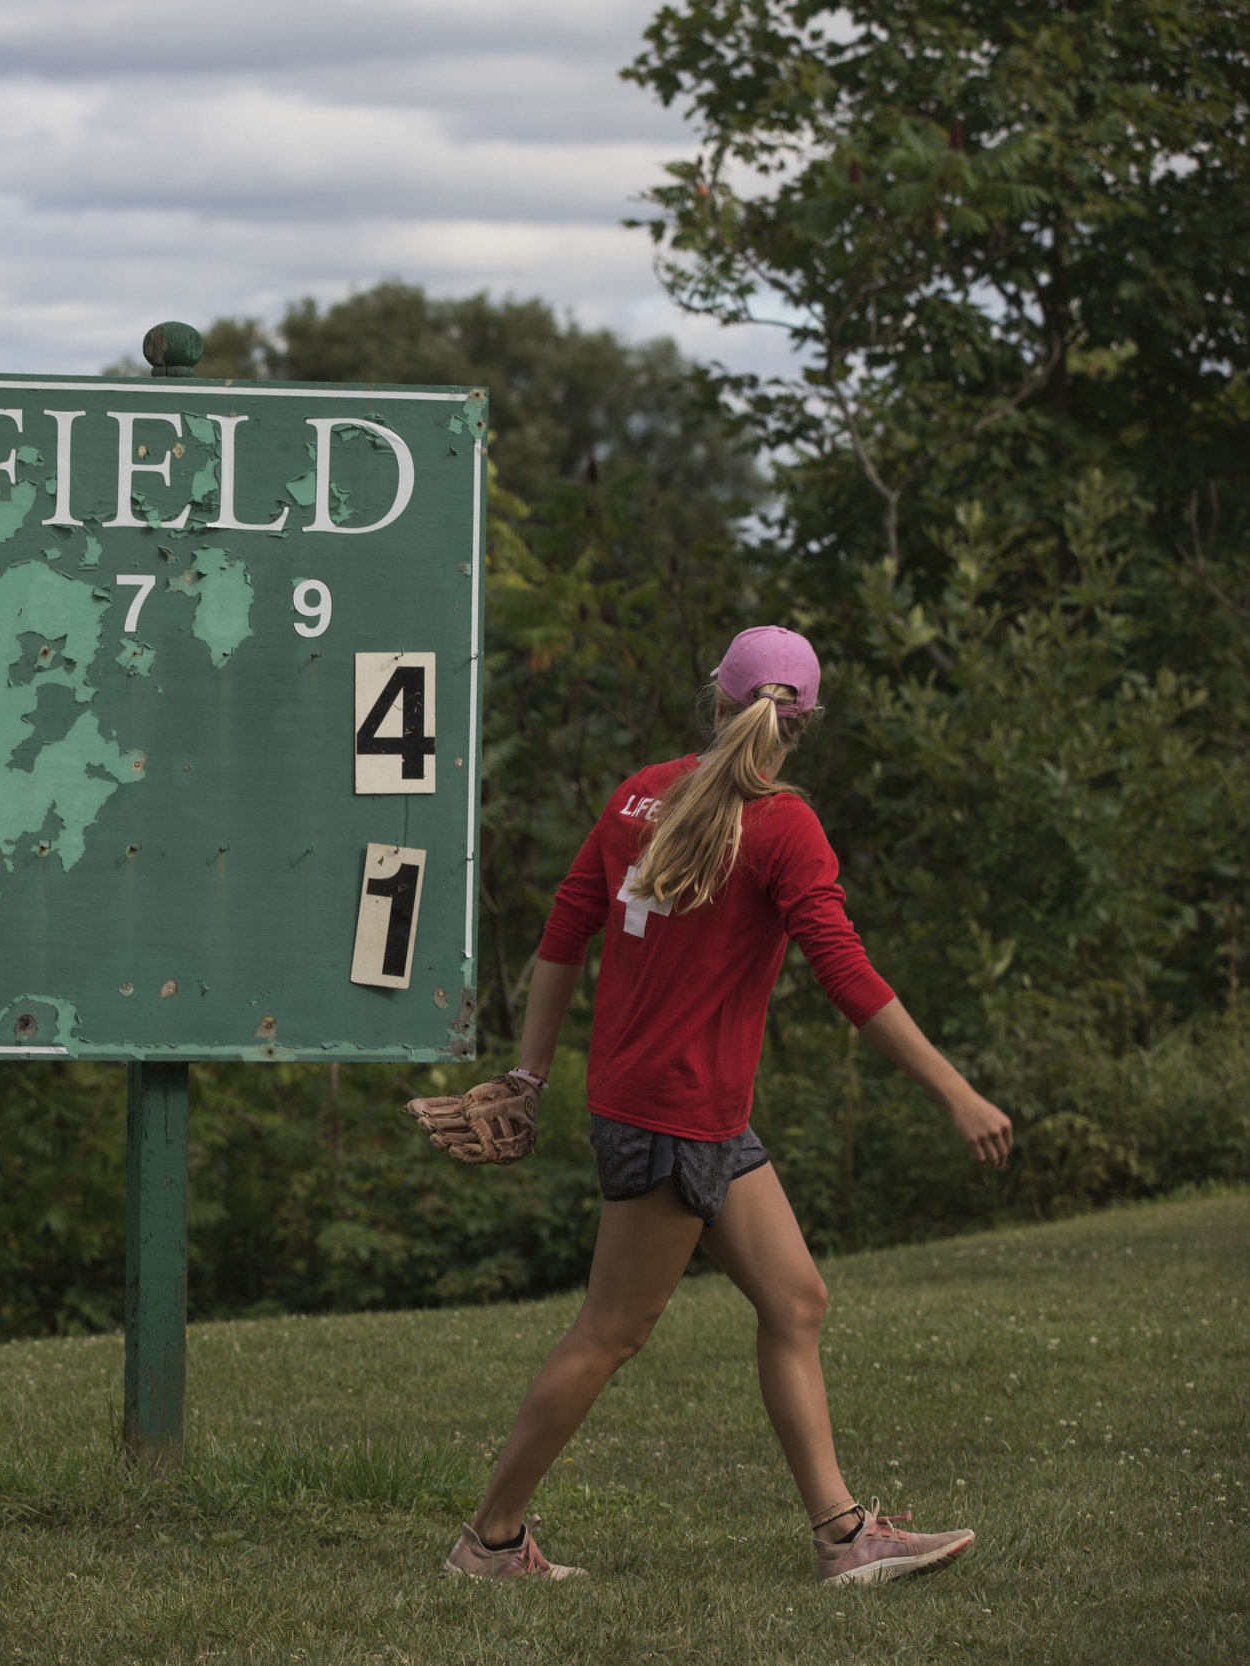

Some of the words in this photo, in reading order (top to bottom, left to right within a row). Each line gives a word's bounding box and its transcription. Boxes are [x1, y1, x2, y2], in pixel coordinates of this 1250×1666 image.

[116, 574, 156, 632] 7
[292, 579, 332, 638] 9
[356, 666, 435, 779] 4
[366, 863, 420, 977] 1
